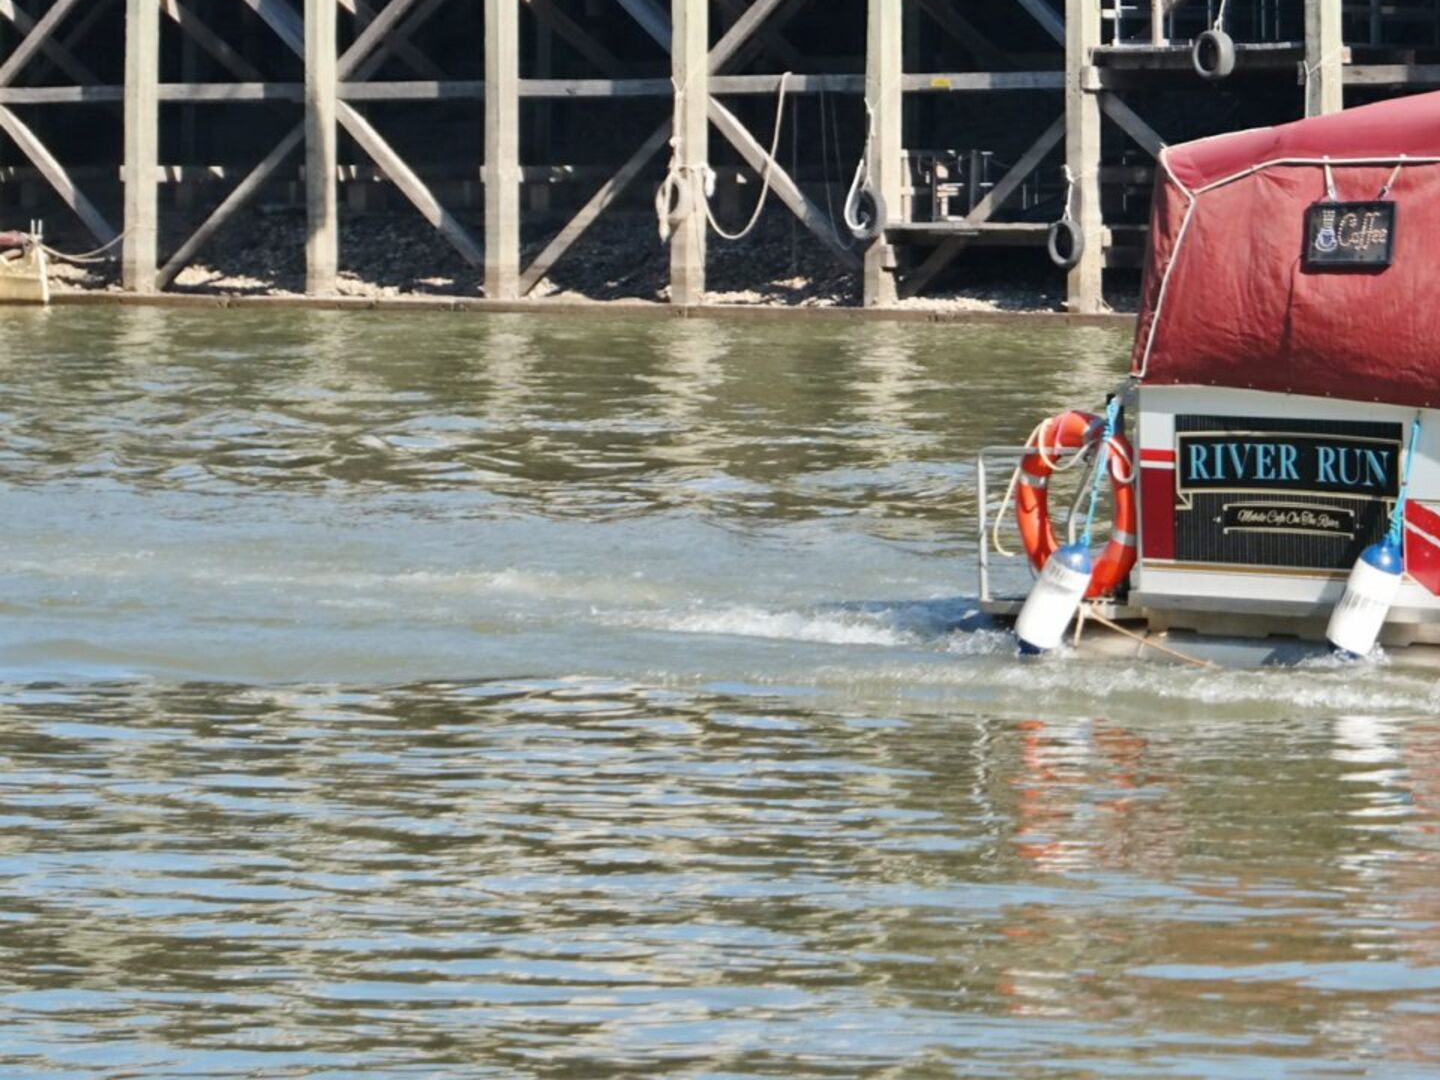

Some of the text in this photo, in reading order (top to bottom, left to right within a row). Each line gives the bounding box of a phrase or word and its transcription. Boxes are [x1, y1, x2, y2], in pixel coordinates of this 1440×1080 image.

[1338, 212, 1387, 250] Coffee
[1188, 443, 1389, 487] RIVER RUN
